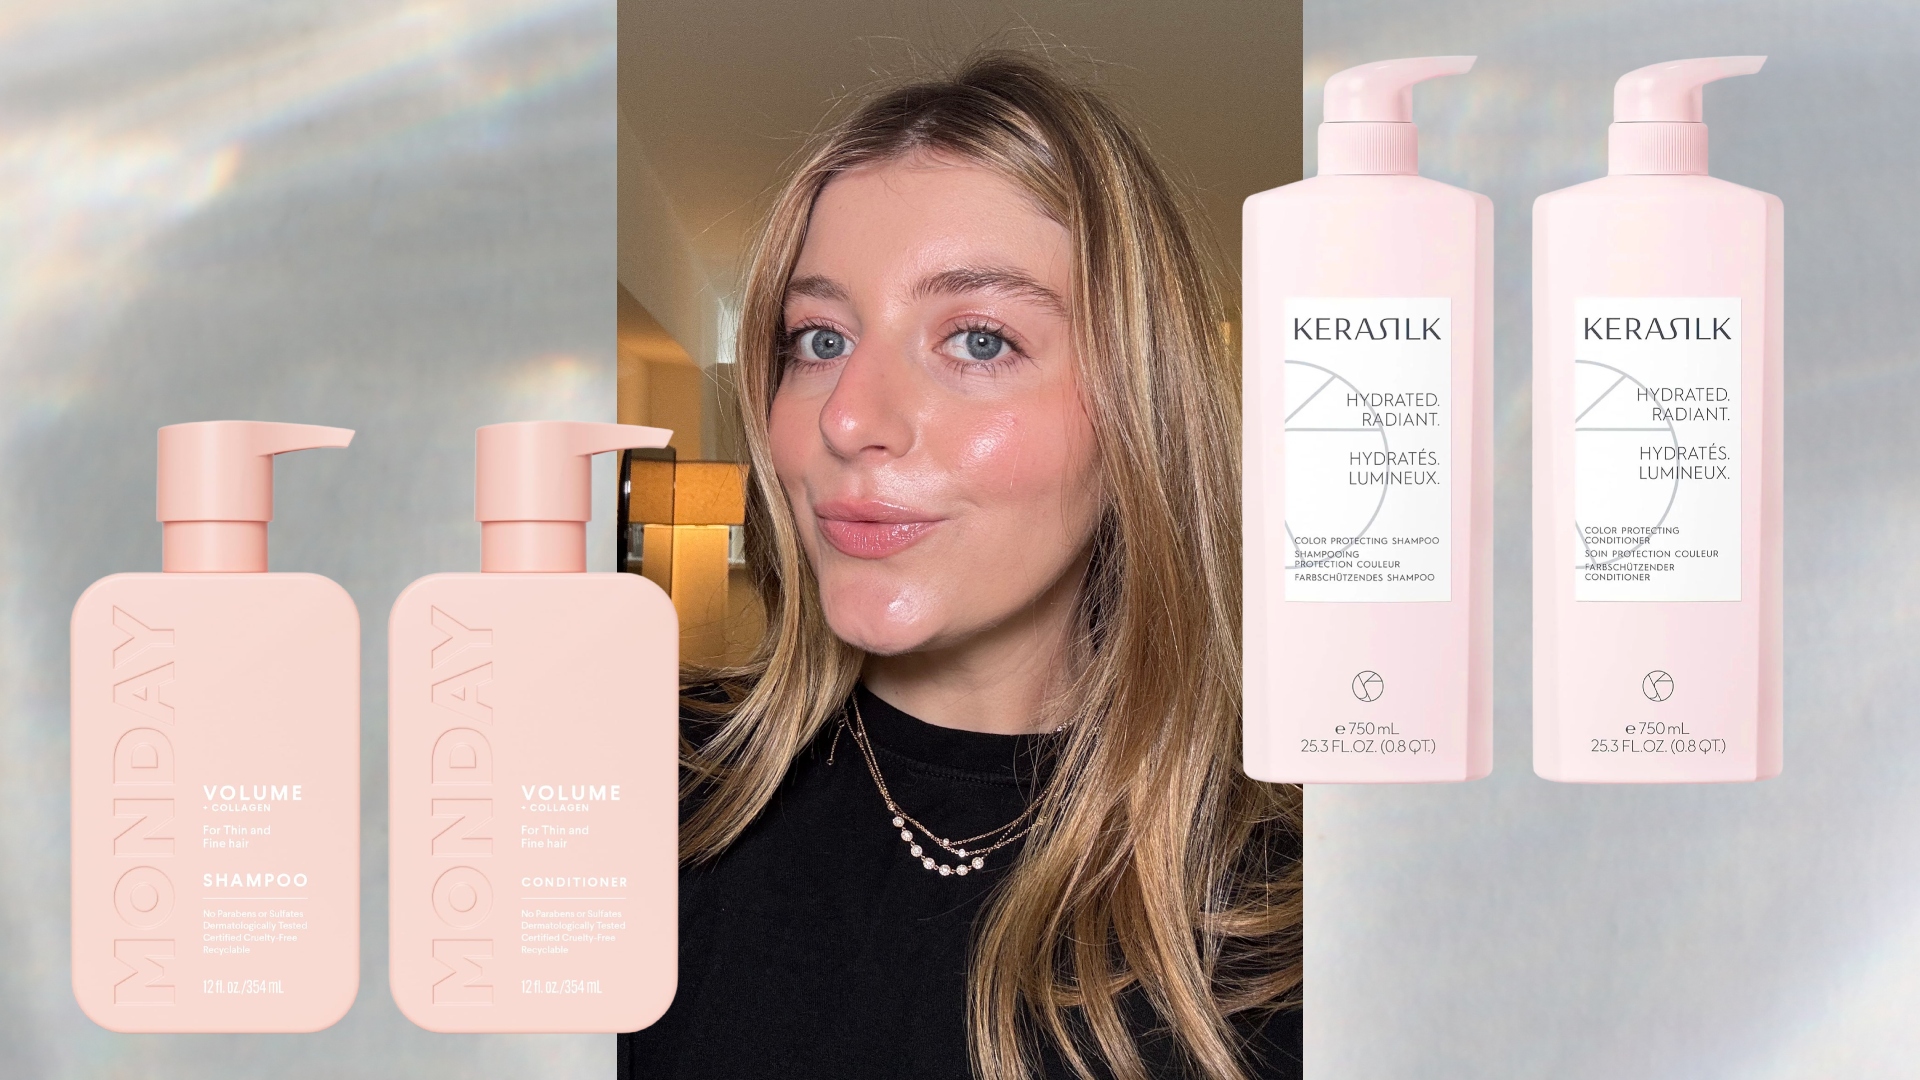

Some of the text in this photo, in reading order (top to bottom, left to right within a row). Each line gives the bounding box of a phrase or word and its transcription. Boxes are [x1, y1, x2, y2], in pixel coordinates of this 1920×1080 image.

[1294, 318, 1441, 340] KERASILK
[1584, 318, 1731, 340] KERASILK
[1347, 393, 1440, 407] HYDRATED.
[1637, 388, 1730, 401] HYDRATED.
[1362, 413, 1440, 426] RADIANT.
[1652, 408, 1730, 421] RADIANT.
[1350, 449, 1440, 465] HYDRATÉS.
[1640, 444, 1730, 460] HYDRATÉS.
[1349, 471, 1440, 485] LUMINEUX.
[1639, 466, 1730, 479] LUMINEUX.
[1295, 537, 1439, 545] COLOR PROTECTING SHAMPOO
[1585, 550, 1718, 558] SOIN PROTECTION COULEUR
[1585, 563, 1674, 571] FARBSCHÜTZENDER
[1295, 573, 1383, 581] FARBSCHÜTZENDES
[1301, 740, 1328, 753] 25.3
[1591, 740, 1618, 753] 25.3
[203, 785, 302, 800] VOLUME
[522, 785, 620, 800] VOLUME
[113, 605, 176, 1005] MONDAY
[431, 605, 494, 1005] MONDAY
[203, 825, 270, 835] For Thin and
[522, 825, 589, 835] For Thin and
[203, 839, 249, 848] Fine hair
[522, 839, 567, 848] Fine hair
[203, 873, 308, 887] SHAMPOO
[521, 877, 627, 887] CONDITIONER
[203, 910, 215, 918] No
[218, 910, 256, 918] Parabens
[270, 910, 304, 918] Sulfates
[522, 910, 533, 918] No
[536, 910, 574, 918] Parabens
[588, 910, 622, 918] Sulfates
[203, 922, 307, 931] Dermatologically Tested
[522, 922, 626, 931] Dermatologically Tested
[203, 934, 297, 943] Certified Cruelty-Free
[521, 934, 615, 943] Certified Cruelty-Free
[203, 946, 250, 955] Recyclable
[522, 946, 568, 955] Recyclable
[203, 980, 213, 993] 12
[522, 980, 531, 993] 12
